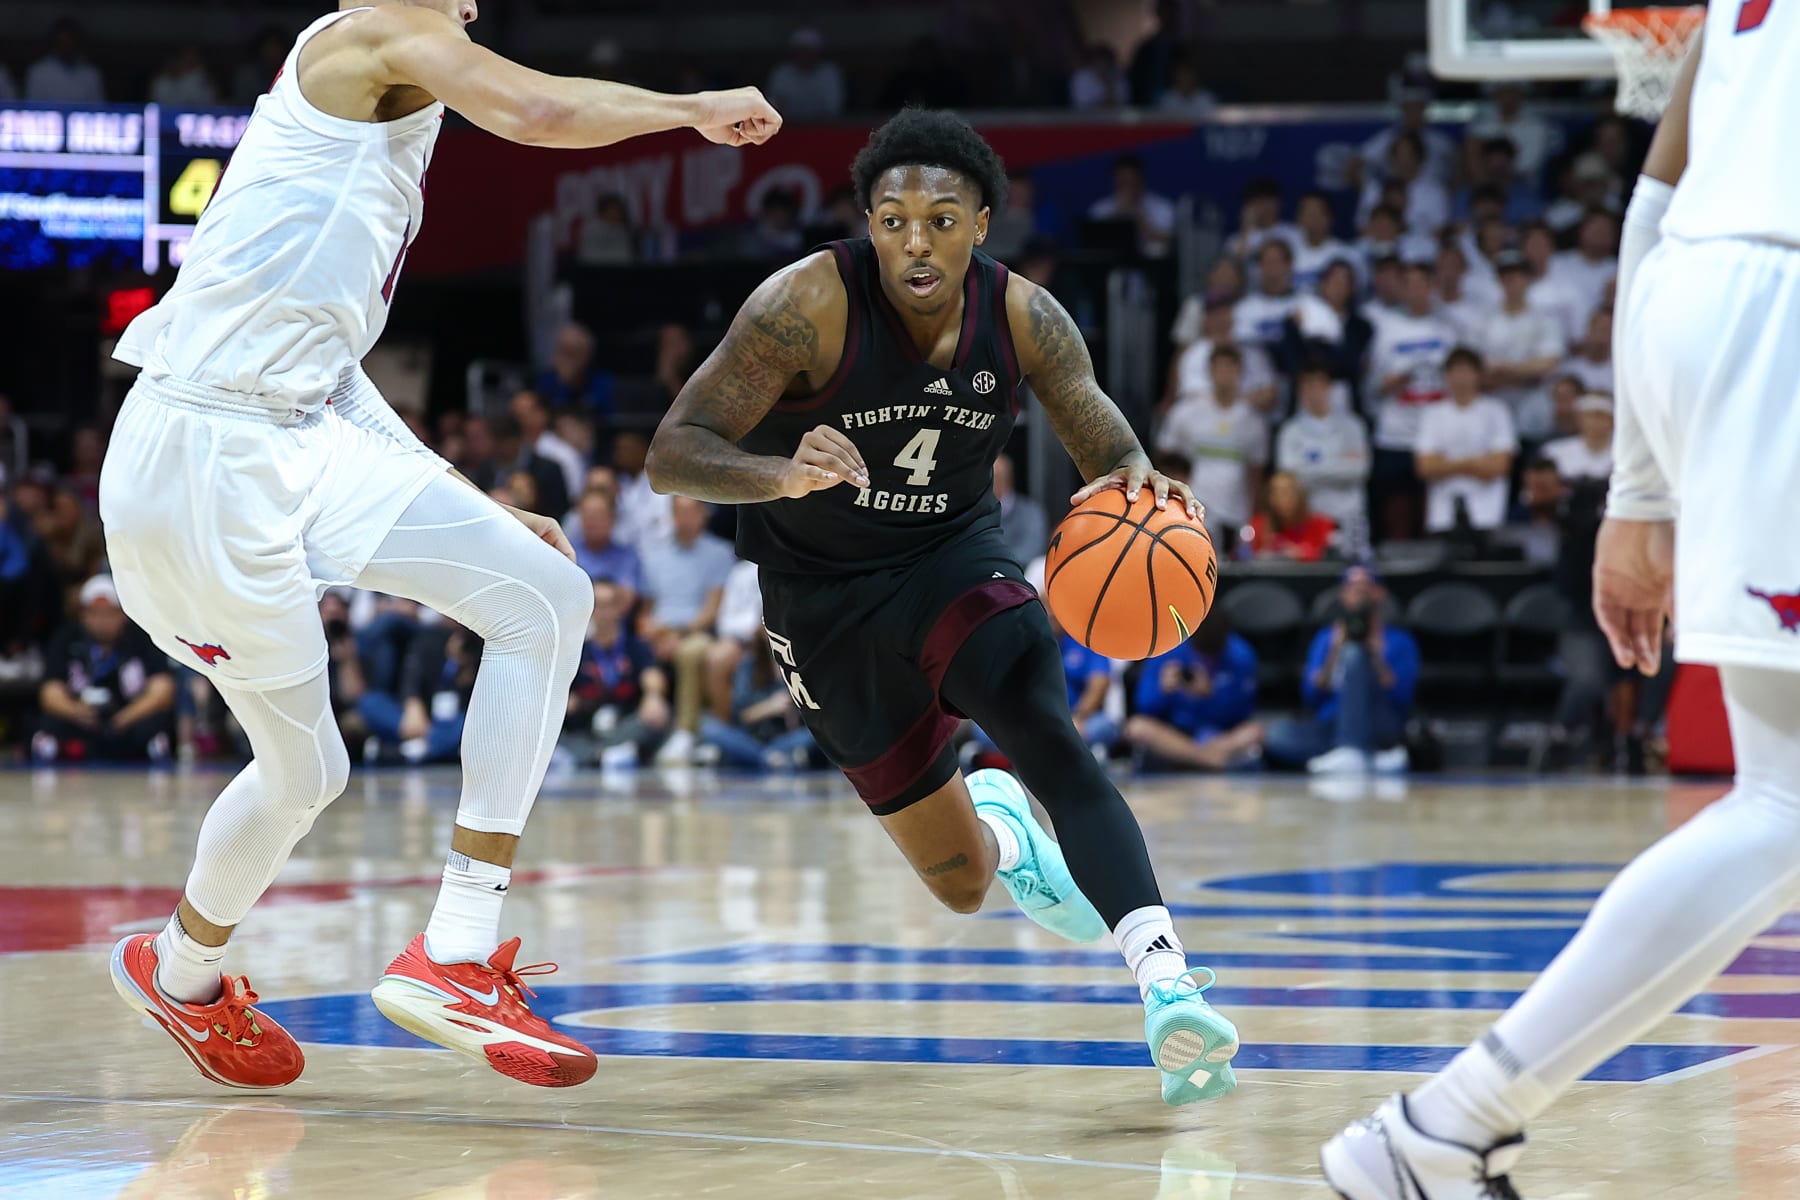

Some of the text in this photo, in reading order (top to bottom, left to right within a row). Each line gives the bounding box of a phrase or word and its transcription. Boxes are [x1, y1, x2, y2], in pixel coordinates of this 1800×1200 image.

[923, 386, 953, 396] adidas
[973, 371, 996, 394] SEC
[943, 405, 996, 430] TEXAS
[893, 428, 942, 486] 4
[854, 488, 949, 514] AGGIES
